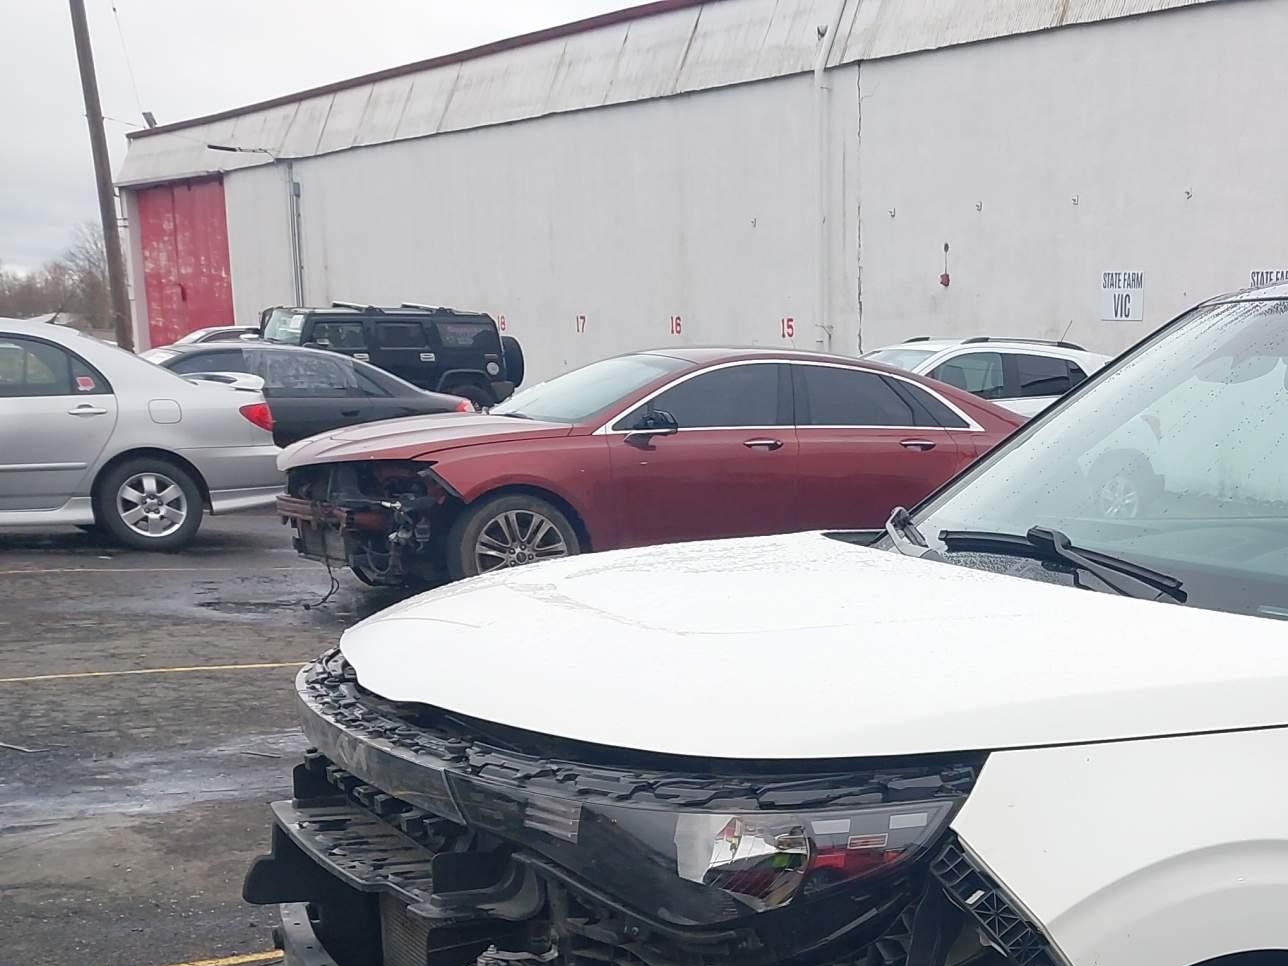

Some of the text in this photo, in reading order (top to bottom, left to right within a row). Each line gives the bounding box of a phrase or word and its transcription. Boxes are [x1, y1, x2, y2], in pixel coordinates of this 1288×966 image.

[1102, 272, 1143, 289] STATE FARM
[1249, 271, 1274, 288] STATE
[1113, 293, 1131, 318] VIC
[576, 315, 586, 333] 17
[670, 316, 682, 335] 16
[781, 318, 794, 338] 15
